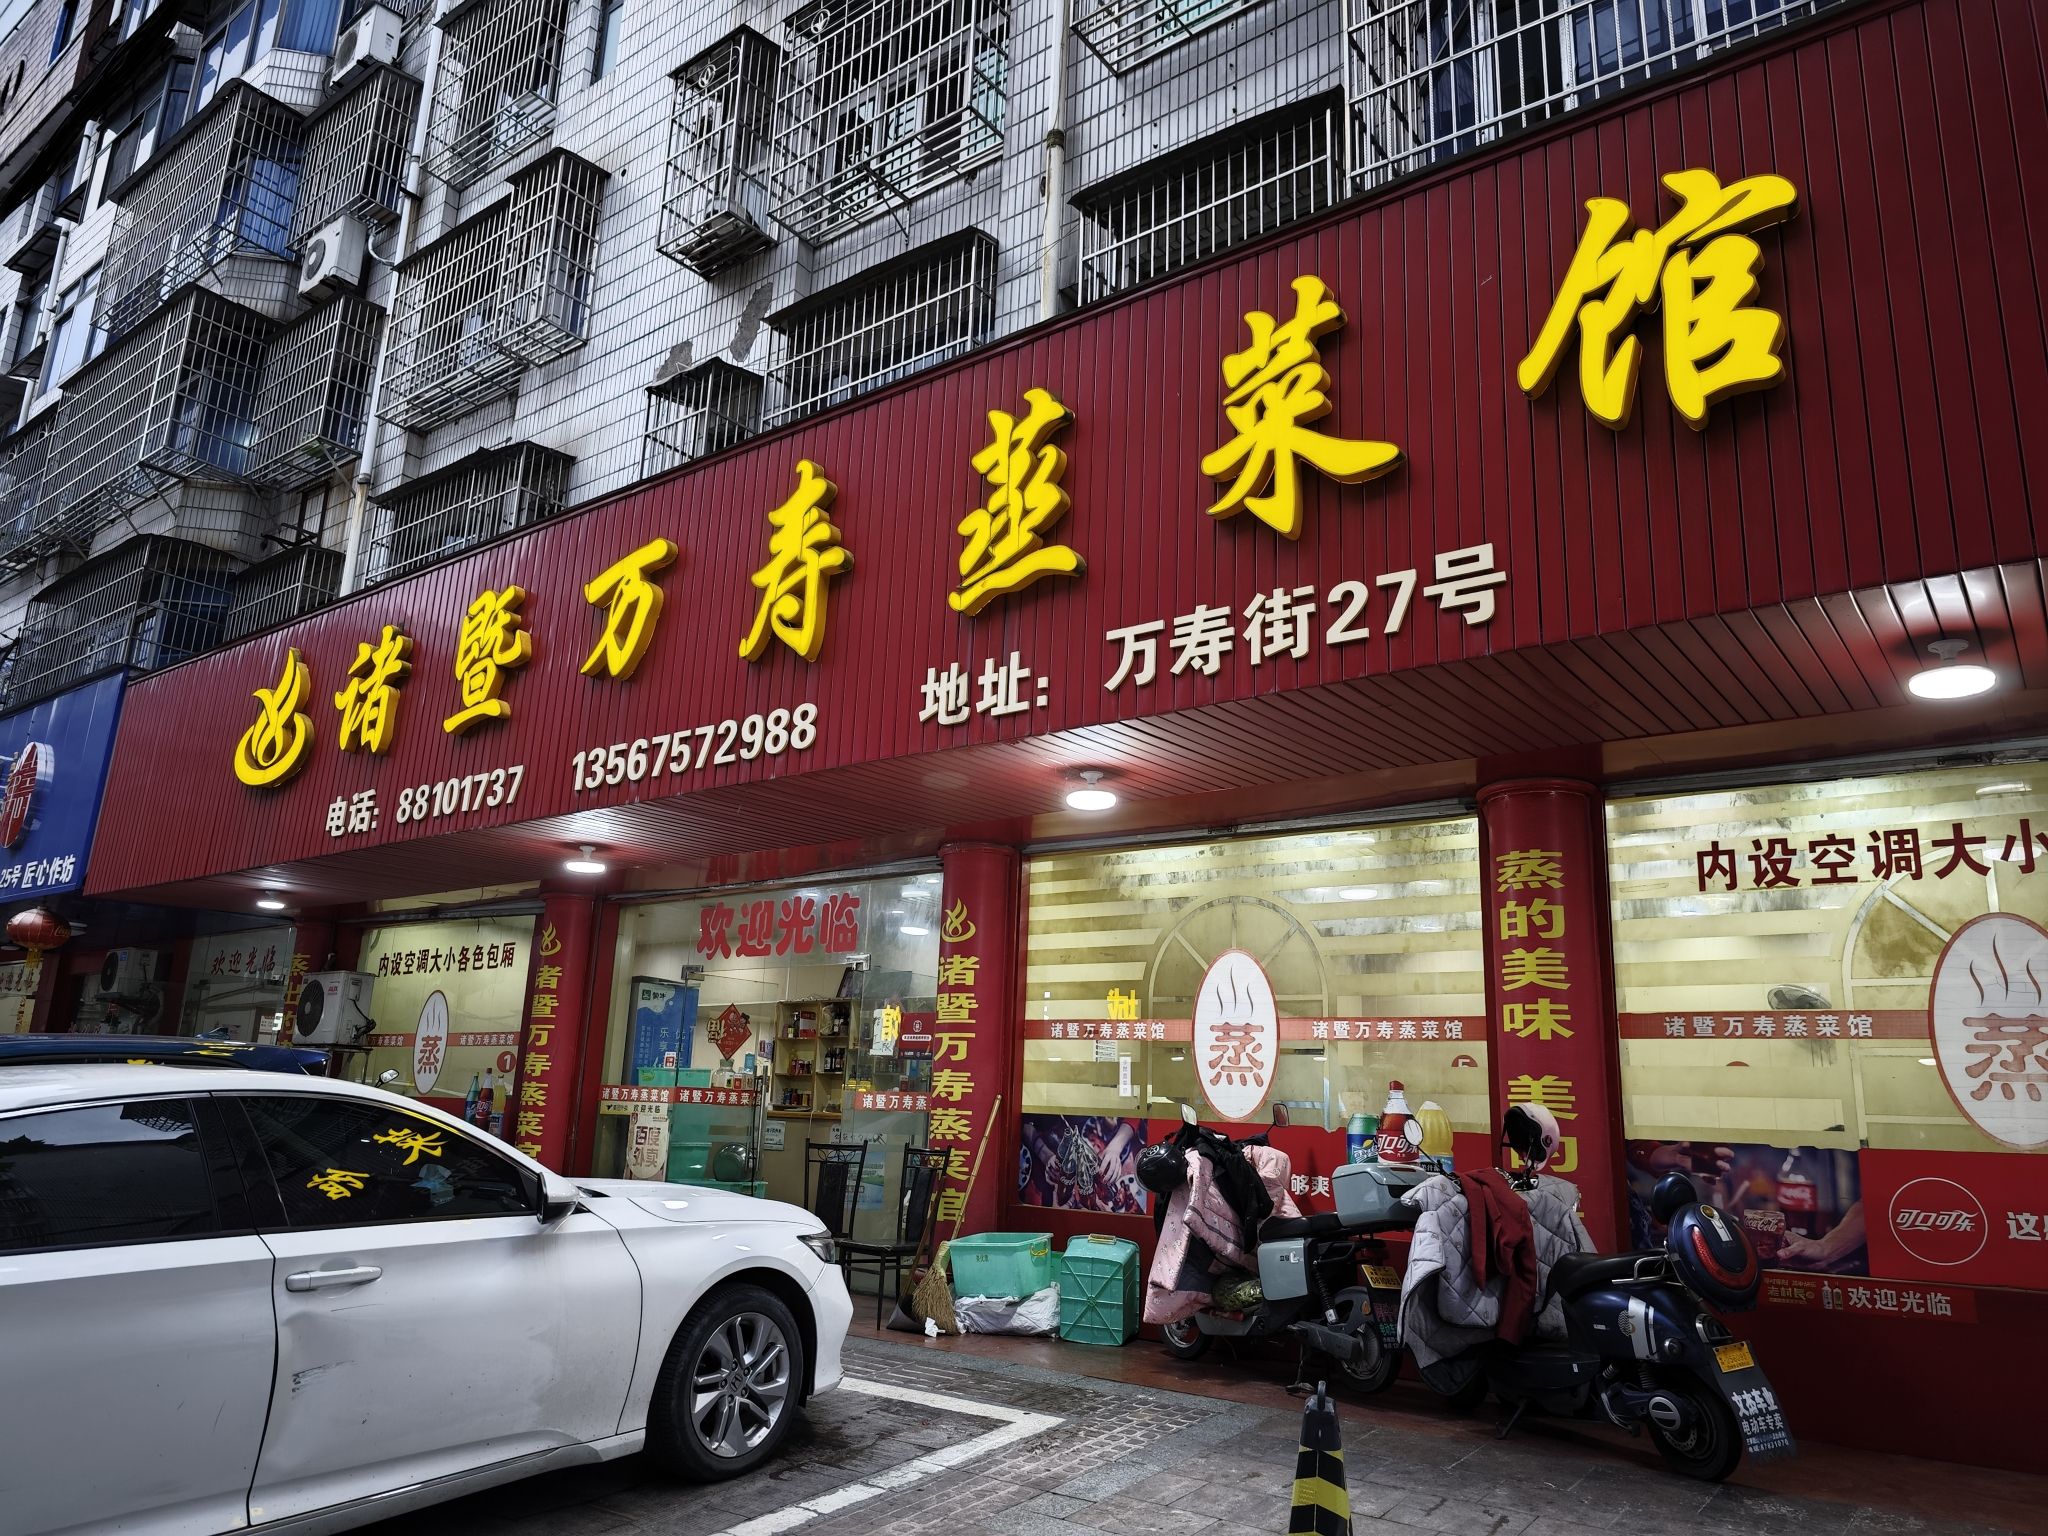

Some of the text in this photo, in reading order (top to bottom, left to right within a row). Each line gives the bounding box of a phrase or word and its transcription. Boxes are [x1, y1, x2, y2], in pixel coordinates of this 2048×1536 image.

[334, 168, 1798, 756] 诸暨万寿蒸菜馆
[395, 764, 525, 827] 88101737
[572, 702, 819, 792] 13567572988
[1104, 543, 1508, 693] 万寿街27号
[1696, 818, 2048, 892] 内设空调大小
[21, 854, 76, 889] 匠心作坊
[696, 893, 861, 961] 欢迎光临
[211, 944, 277, 976] 欢迎光临
[378, 942, 516, 978] 内设空调大小各色包厢
[1496, 848, 1575, 1041] 蒸的美味
[459, 1034, 515, 1046] 诸暨万寿蒸菜馆
[1051, 1022, 1165, 1040] 诸暨万寿蒸菜馆
[1312, 1020, 1464, 1040] 诸暨万寿蒸菜馆
[1664, 1015, 1874, 1039] 诸暨万寿蒸菜馆
[417, 1035, 443, 1075] 蒸
[503, 1055, 512, 1071] 1
[1208, 1021, 1266, 1088] 蒸
[1962, 1012, 2048, 1101] 蒸
[602, 1087, 670, 1105] 诸暨万寿蒸菜馆
[635, 1126, 661, 1146] 百度
[633, 1147, 658, 1168] 外卖
[1291, 1173, 1331, 1198] 够爽
[1896, 1208, 2048, 1242] 可口可乐 这
[1847, 1286, 1952, 1317] 欢迎光临
[1741, 1412, 1784, 1435] 电动车专卖
